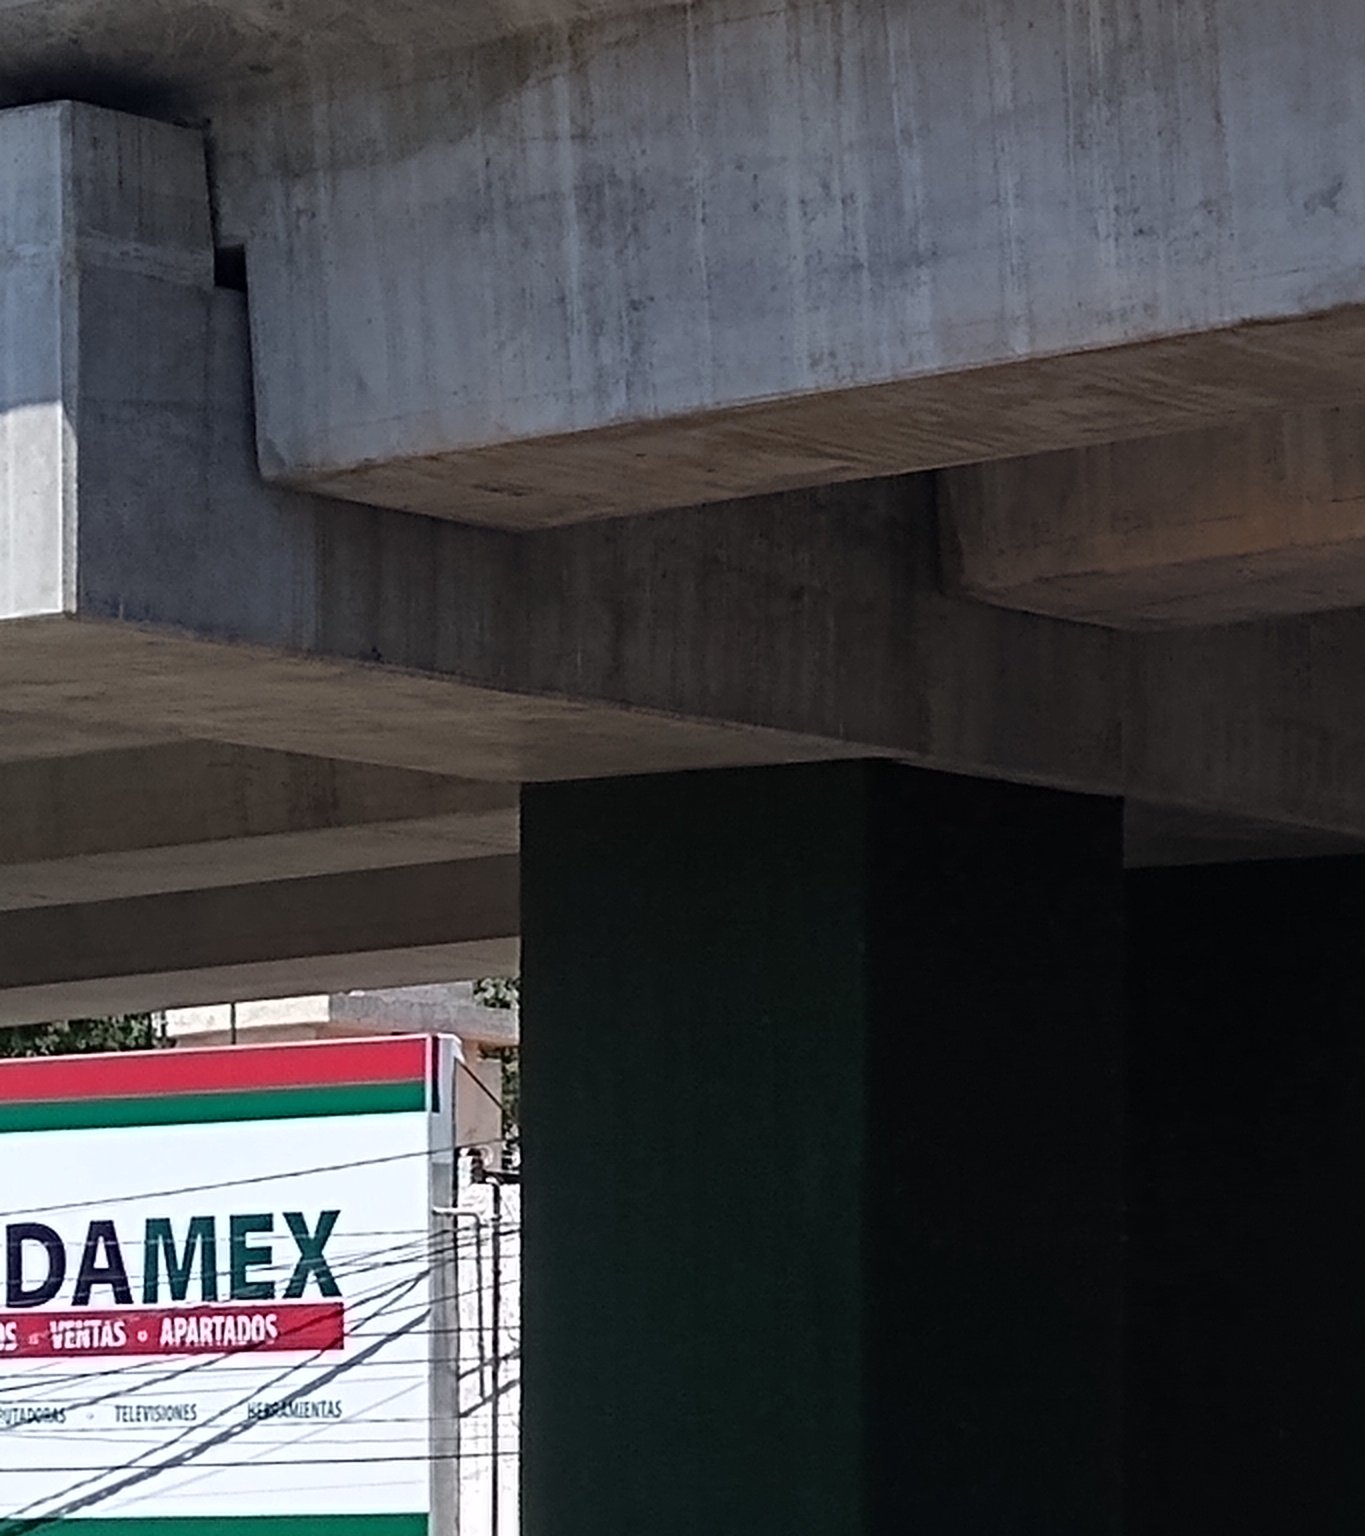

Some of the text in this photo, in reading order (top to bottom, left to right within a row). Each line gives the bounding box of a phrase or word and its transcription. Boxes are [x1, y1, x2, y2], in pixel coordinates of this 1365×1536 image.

[50, 1318, 126, 1349] VENTAS
[160, 1313, 278, 1346] APARTADOS
[115, 1403, 197, 1422] TELEVISIONES
